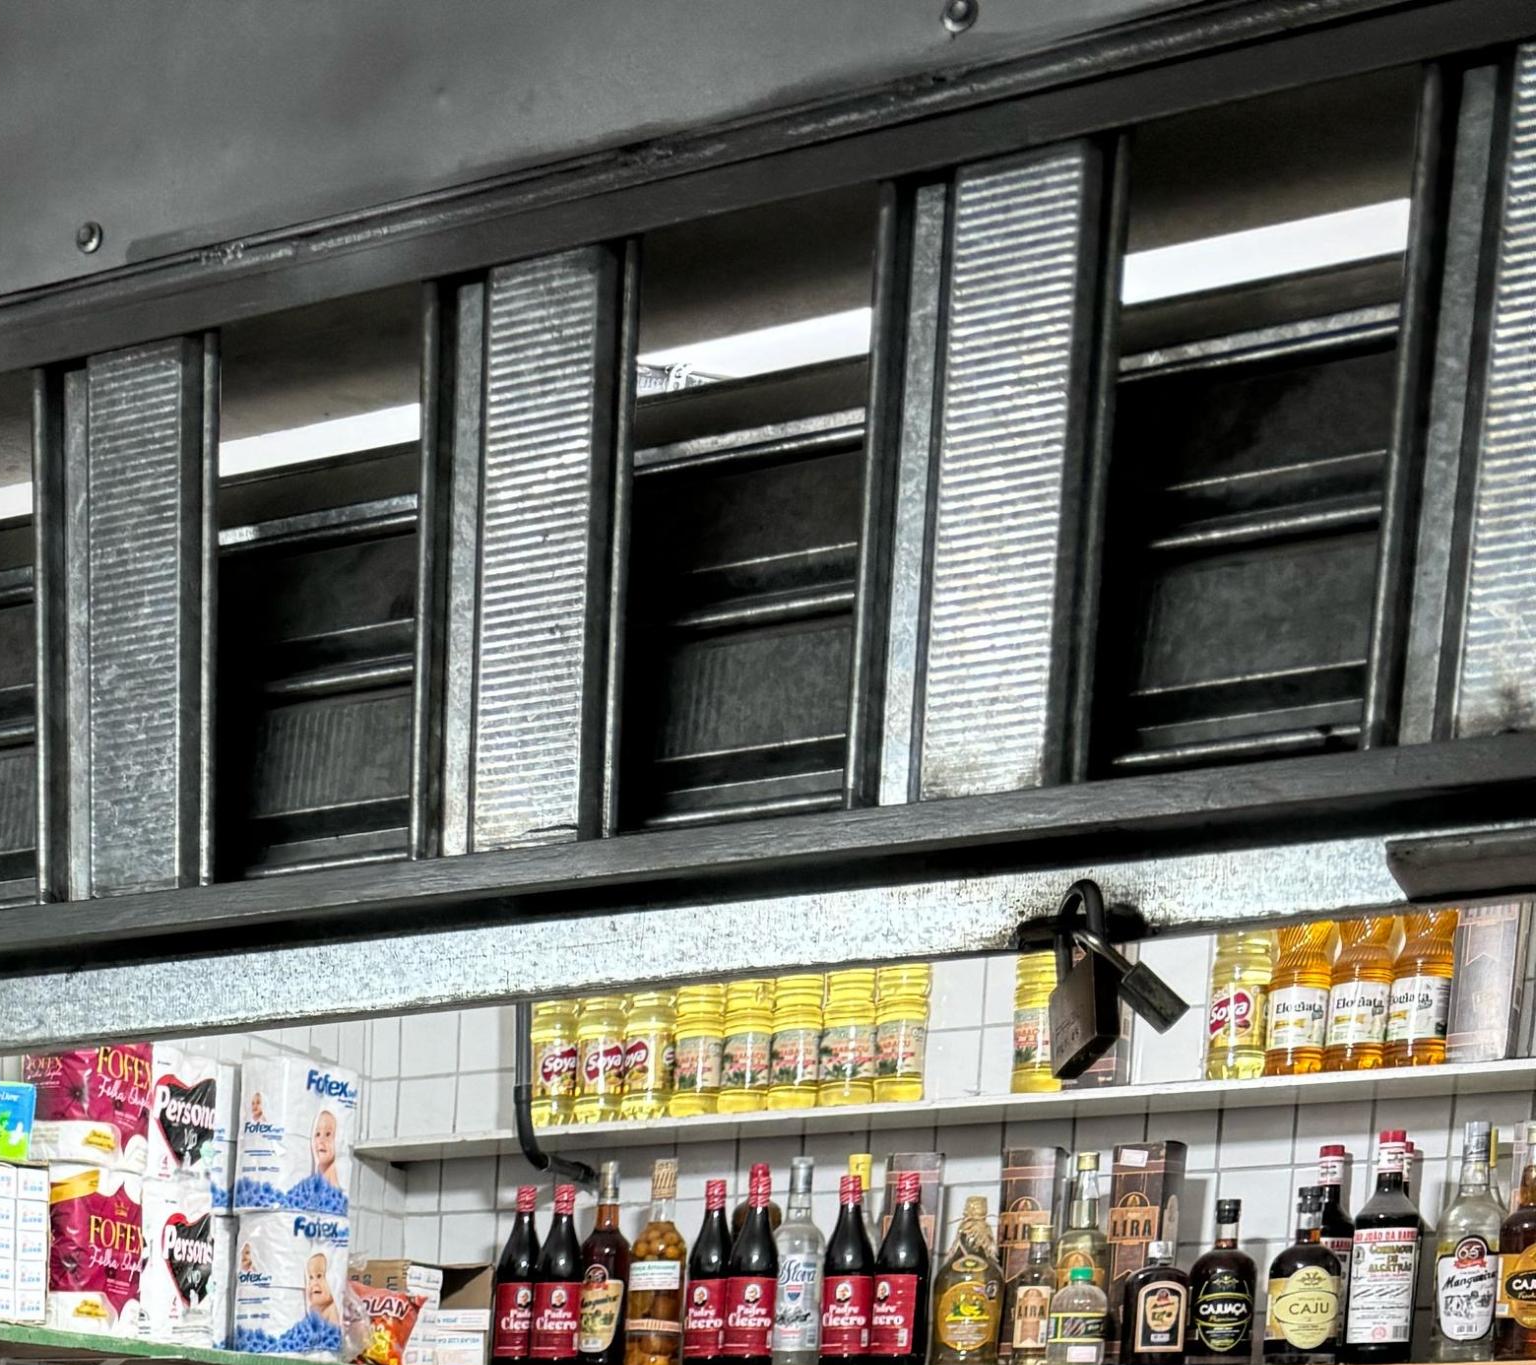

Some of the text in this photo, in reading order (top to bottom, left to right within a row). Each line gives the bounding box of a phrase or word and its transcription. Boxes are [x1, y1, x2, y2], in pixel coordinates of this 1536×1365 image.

[1210, 999, 1250, 1025] Soya
[585, 1051, 623, 1072] Soya
[306, 1069, 350, 1097] Fofex
[243, 1121, 273, 1134] Fofex
[294, 1217, 338, 1238] Fofex
[1111, 1219, 1153, 1237] LIRA
[544, 1309, 573, 1319] Padre
[736, 1304, 768, 1316] Padre
[828, 1304, 860, 1315] Padre
[1016, 1305, 1048, 1319] LIRA
[1199, 1303, 1247, 1316] CAJUAÇA
[1289, 1302, 1330, 1314] CAJU
[536, 1317, 578, 1331] Cicero
[728, 1314, 772, 1328] Cicero
[822, 1313, 866, 1327] Cicero
